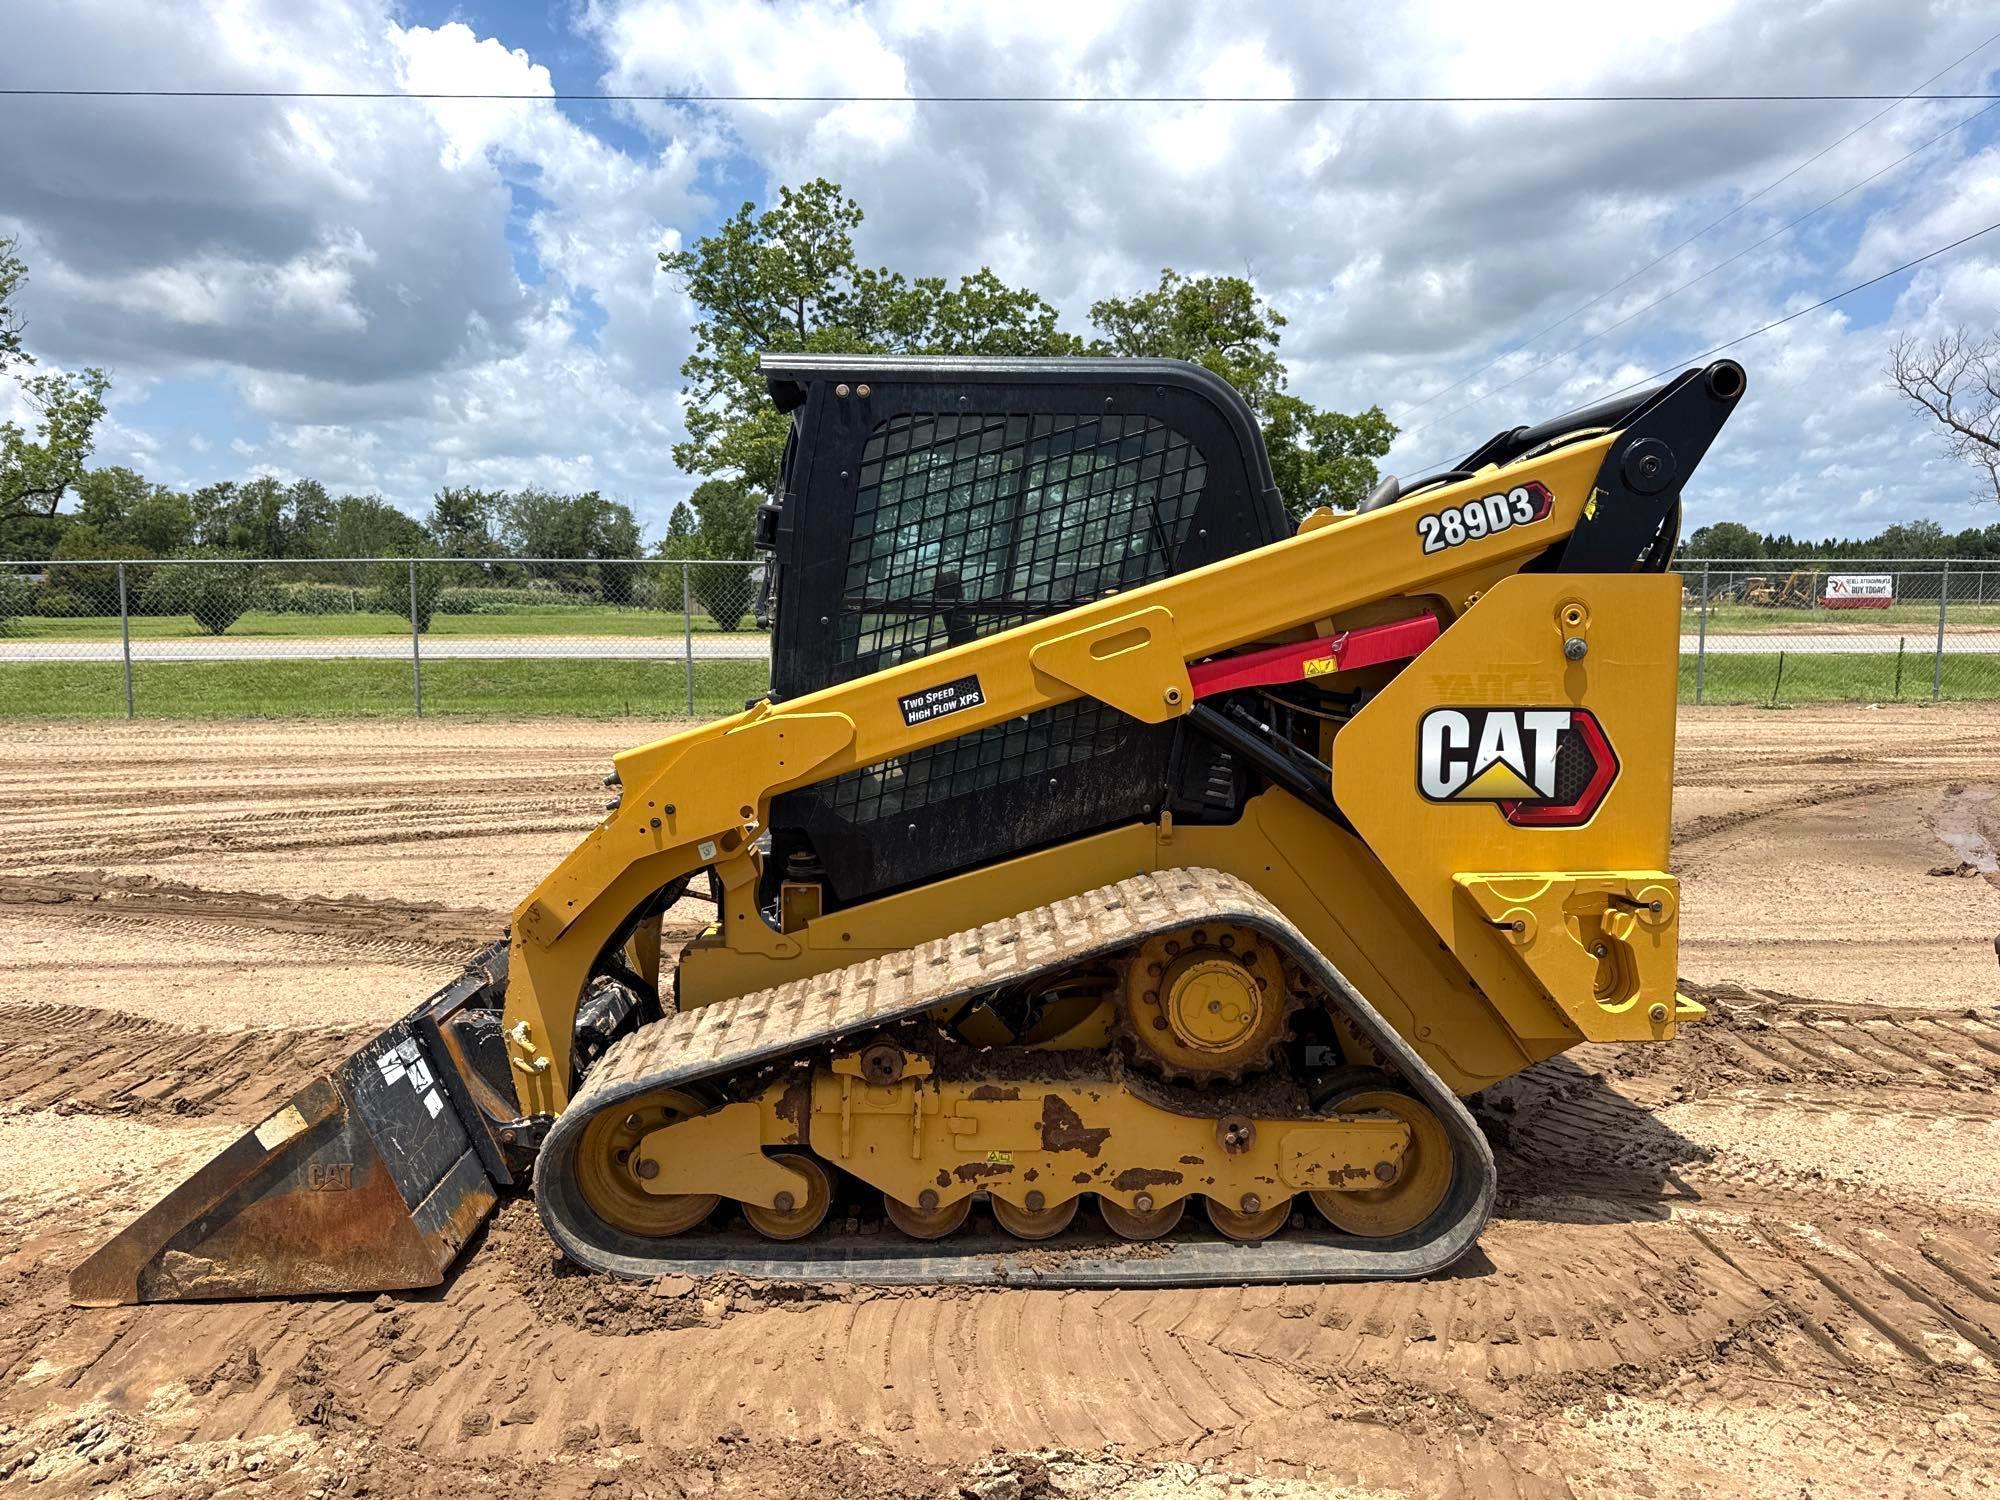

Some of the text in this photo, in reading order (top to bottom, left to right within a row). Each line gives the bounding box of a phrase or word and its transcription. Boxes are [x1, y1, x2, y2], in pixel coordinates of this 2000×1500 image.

[1419, 487, 1534, 553] 289D3
[1851, 586, 1886, 594] BUY TODAY!
[960, 692, 979, 707] XPS
[1421, 710, 1571, 799] CAT
[309, 1163, 354, 1191] CAT
